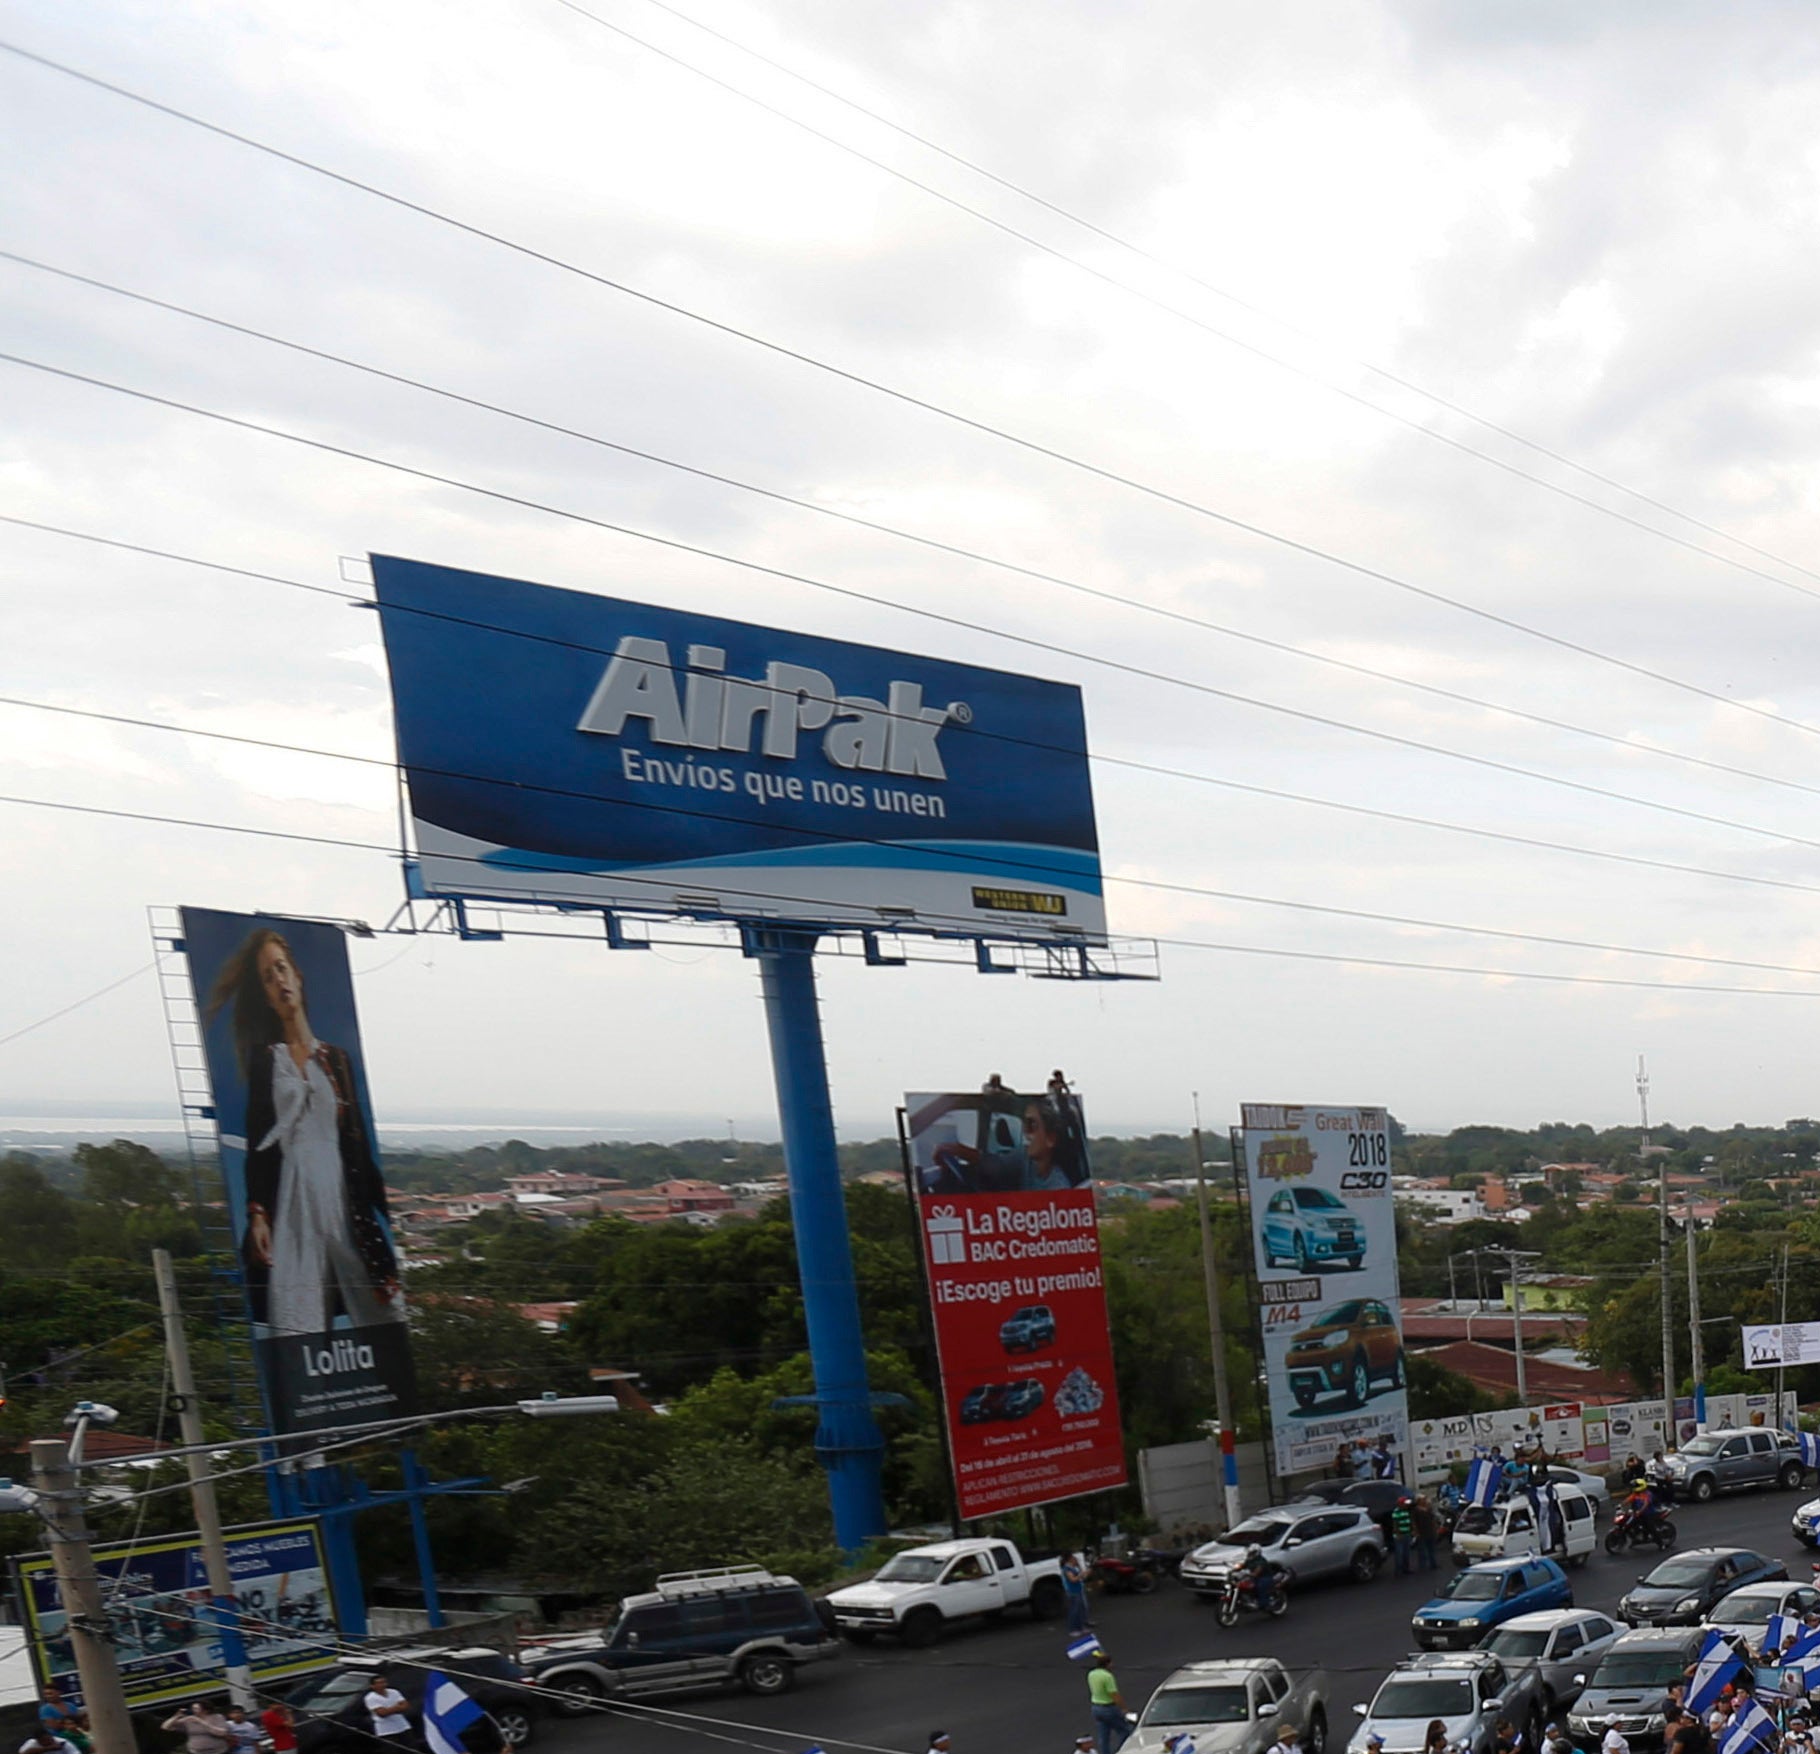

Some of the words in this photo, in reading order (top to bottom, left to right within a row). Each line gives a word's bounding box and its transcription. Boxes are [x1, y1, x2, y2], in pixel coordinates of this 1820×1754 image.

[623, 748, 736, 793] Envíos
[745, 770, 803, 803] que
[812, 777, 865, 808] nos
[874, 785, 946, 818] unen
[1315, 1112, 1353, 1131] Great
[1357, 1111, 1387, 1132] Wall
[1348, 1134, 1388, 1167] 2018
[1340, 1172, 1388, 1190] C30
[966, 1207, 994, 1235] La
[997, 1201, 1094, 1237] Regalona
[970, 1240, 1007, 1262] BAC
[1009, 1233, 1098, 1260] Credomatic
[936, 1278, 1011, 1304] ¡Escoge
[1015, 1276, 1035, 1296] tu
[1037, 1266, 1102, 1297] premio!
[1263, 1282, 1285, 1303] FULL
[1286, 1280, 1319, 1302] EQUIPO
[1266, 1304, 1301, 1326] M4
[262, 1534, 310, 1553] MUEBLES
